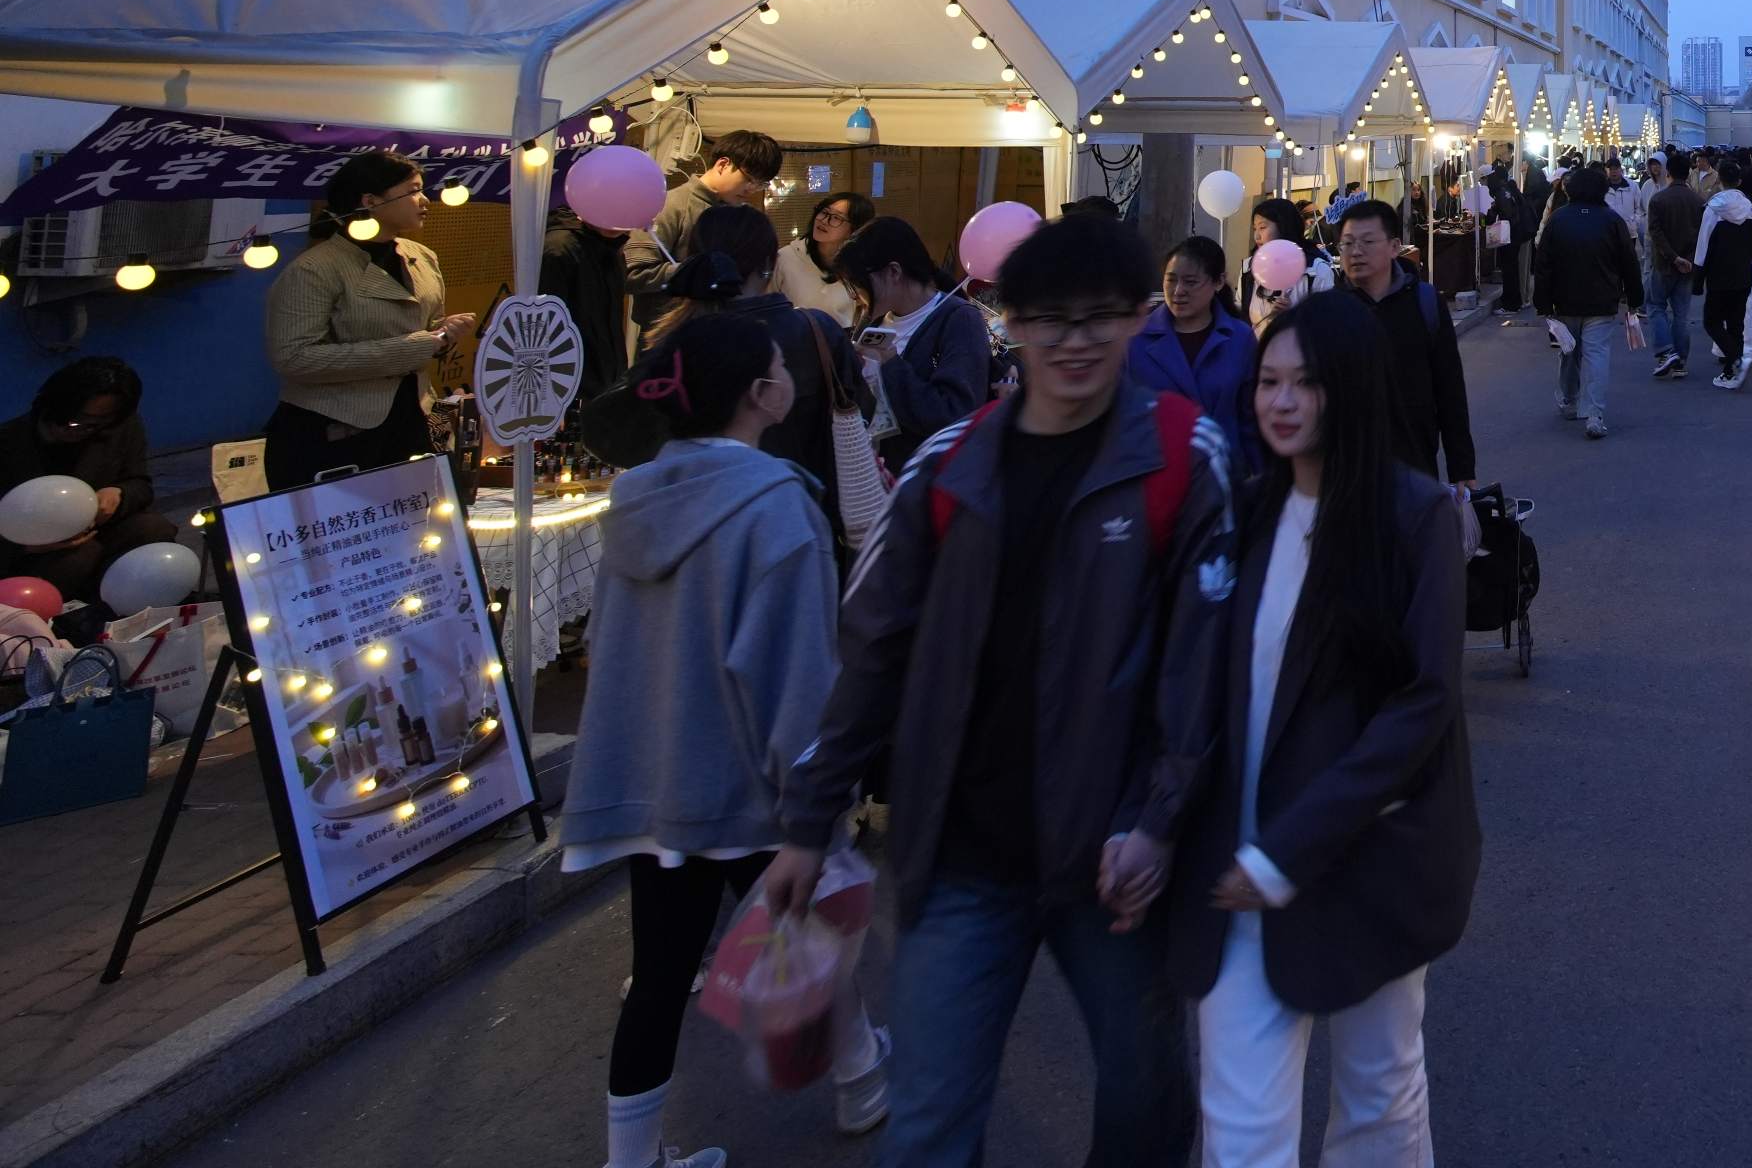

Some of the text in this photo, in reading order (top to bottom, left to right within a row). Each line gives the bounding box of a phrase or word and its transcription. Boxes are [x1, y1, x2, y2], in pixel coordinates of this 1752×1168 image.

[264, 490, 432, 552] 【小多自然芳香工作室】
[339, 545, 383, 569] 产品特色
